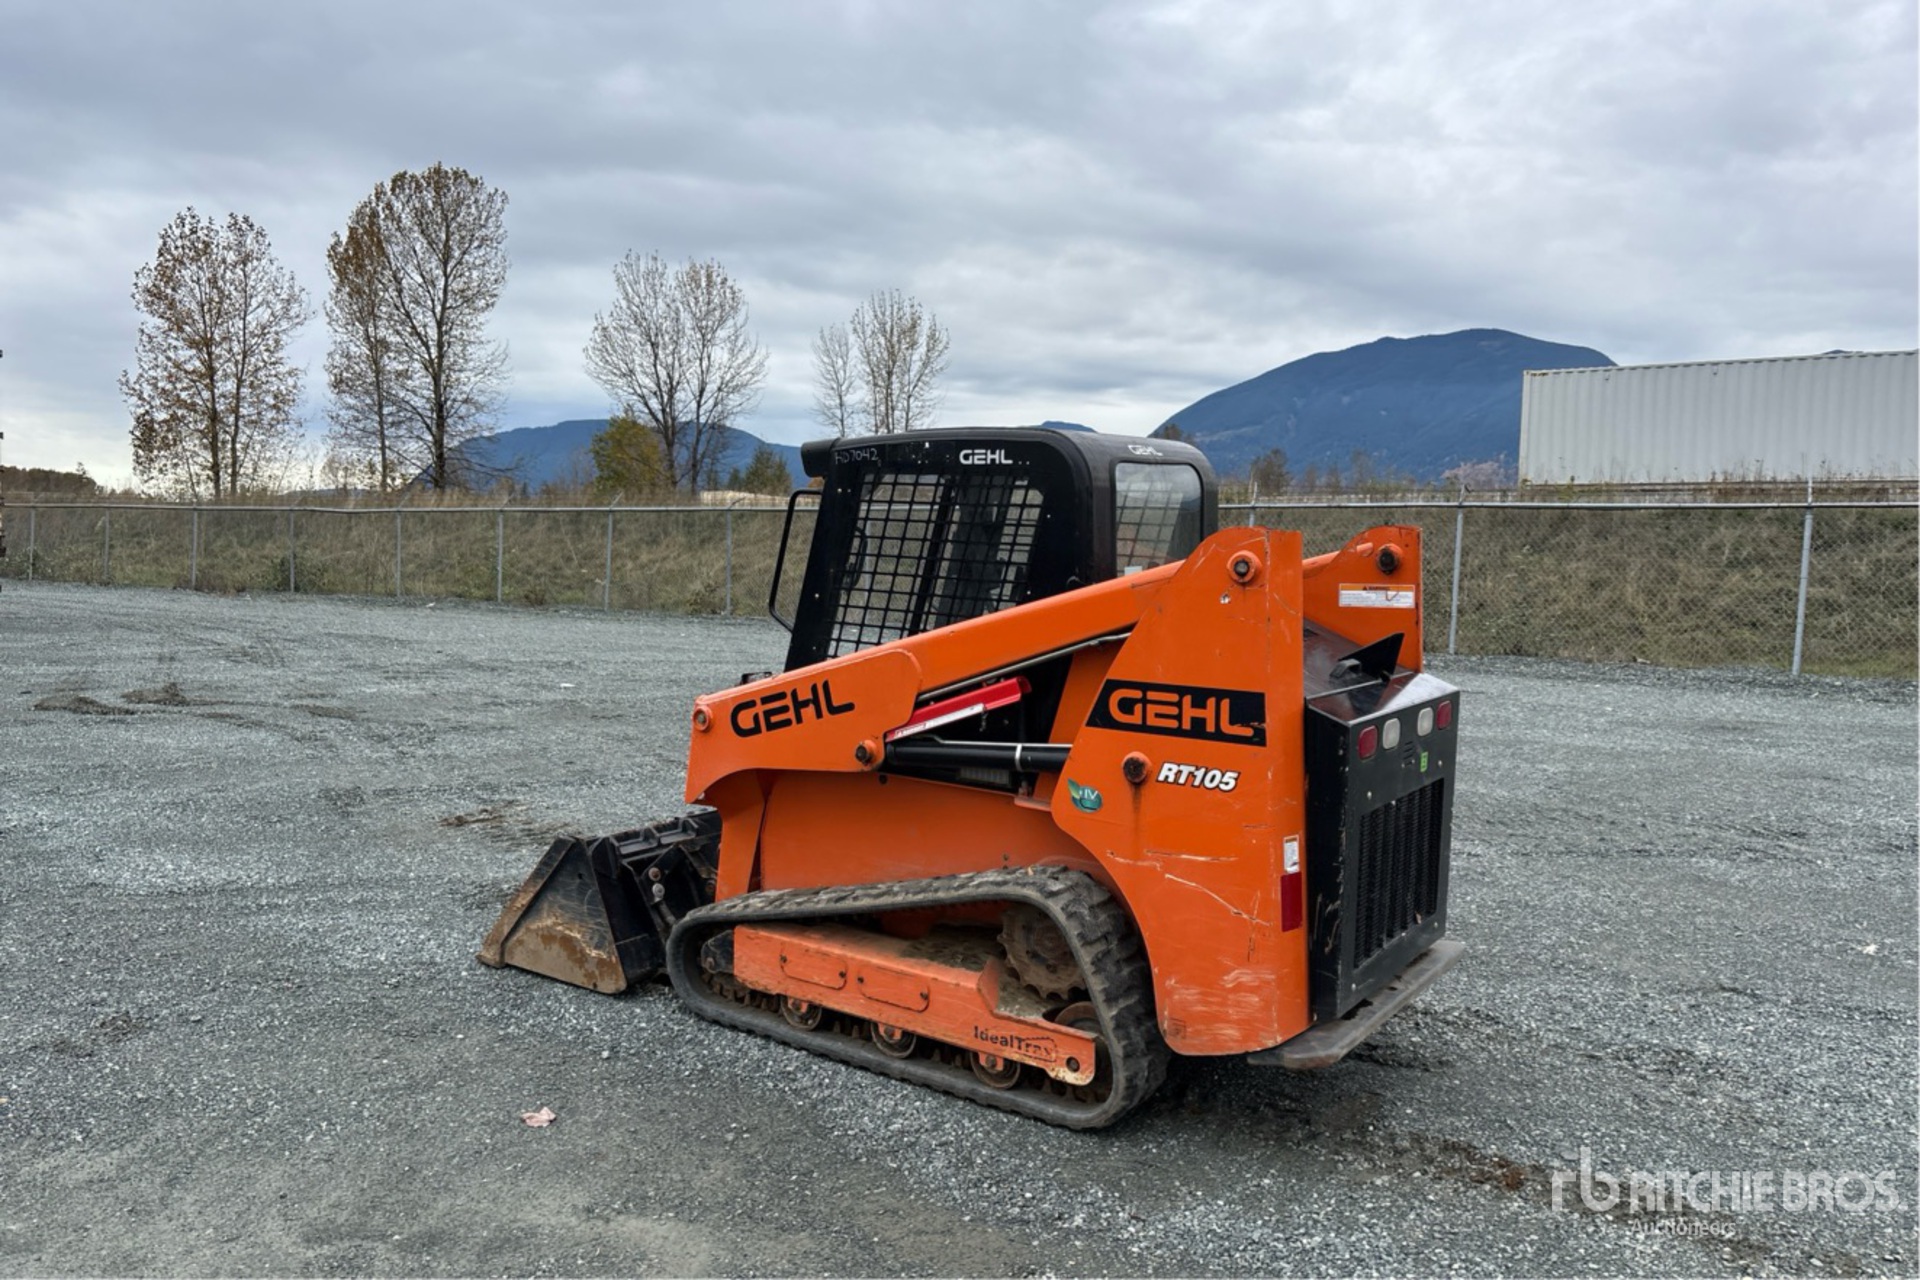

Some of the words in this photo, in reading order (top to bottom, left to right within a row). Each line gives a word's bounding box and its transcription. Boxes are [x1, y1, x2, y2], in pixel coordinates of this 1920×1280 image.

[959, 449, 1013, 465] GEHL
[730, 679, 855, 738] GEHL
[1108, 688, 1254, 737] GEHL
[1156, 762, 1241, 793] RT105
